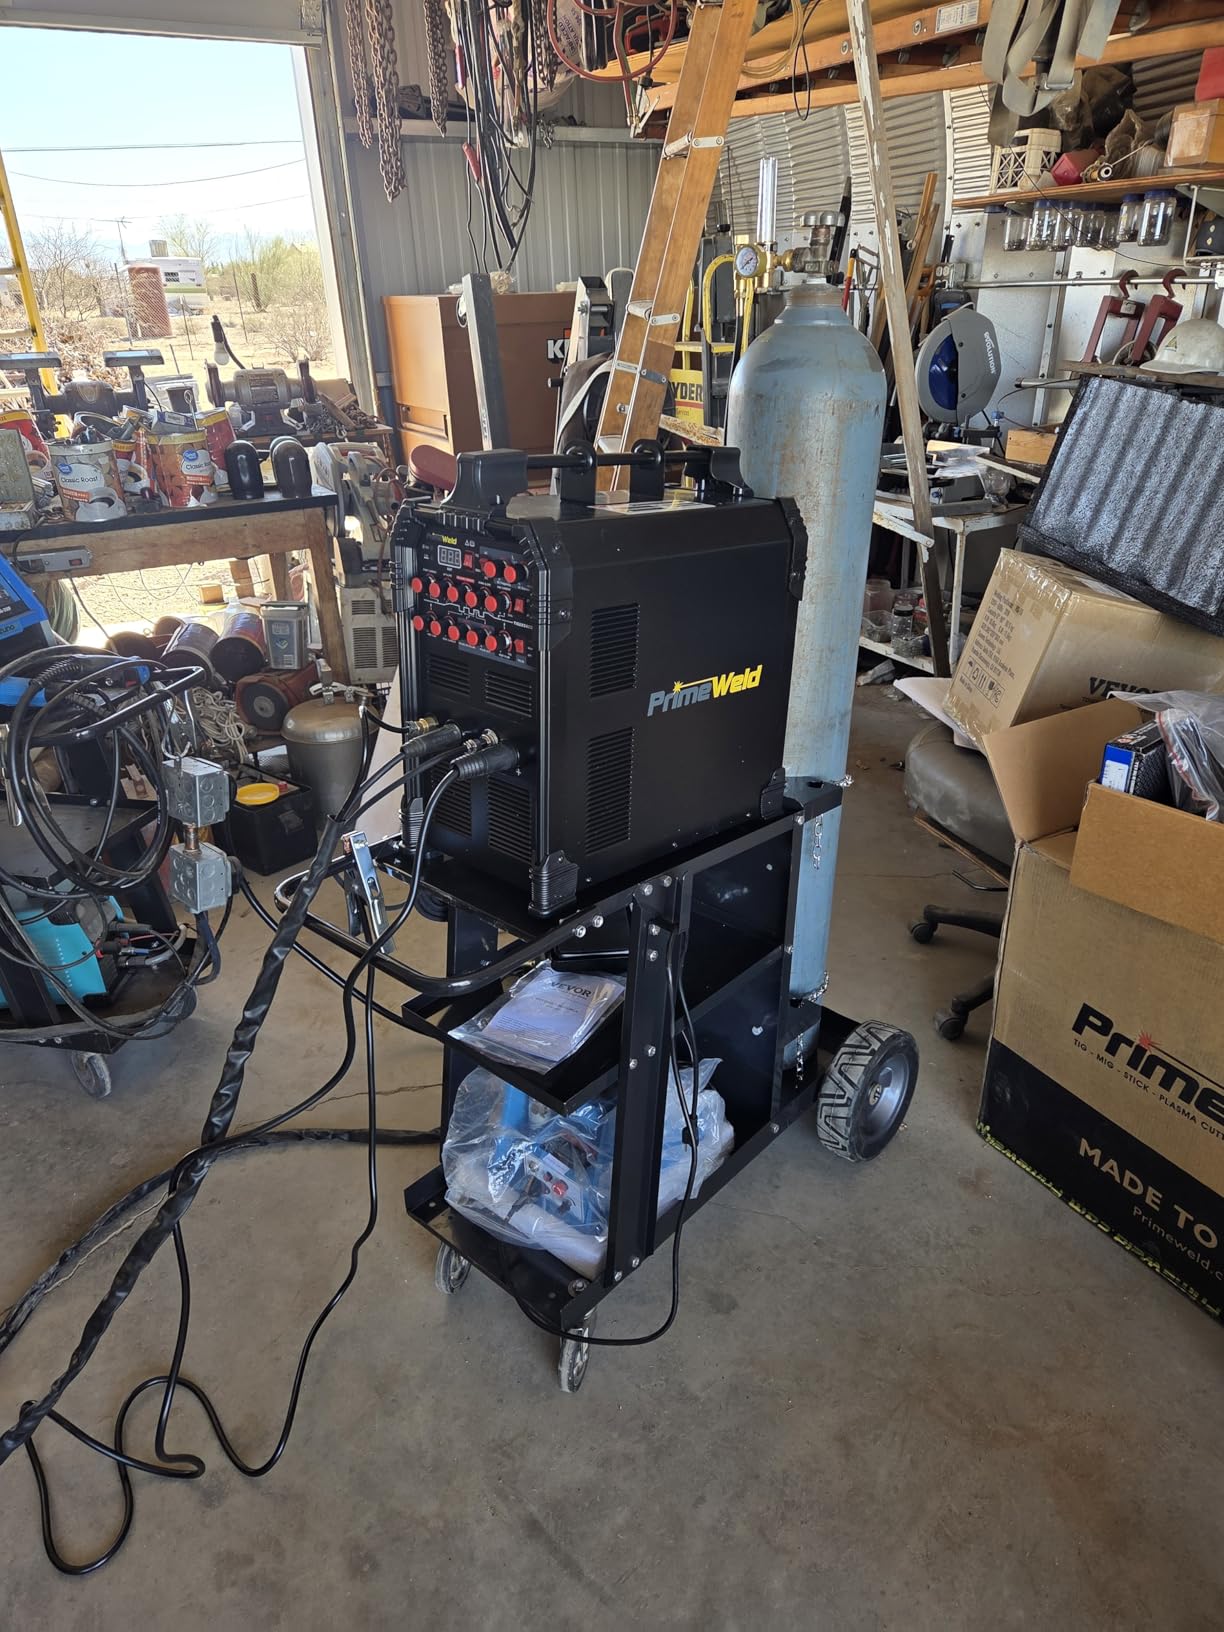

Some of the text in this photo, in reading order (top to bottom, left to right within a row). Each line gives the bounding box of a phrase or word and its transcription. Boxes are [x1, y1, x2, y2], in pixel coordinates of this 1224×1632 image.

[672, 382, 703, 402] YDER
[647, 665, 763, 717] PrimeWeld
[551, 981, 592, 998] VEVOR
[1073, 1038, 1088, 1052] TIG
[1096, 1053, 1115, 1070] MIG
[1123, 1071, 1150, 1094] STICK
[1159, 1094, 1198, 1125] PLASMA
[1079, 1137, 1219, 1249] MADE TO
